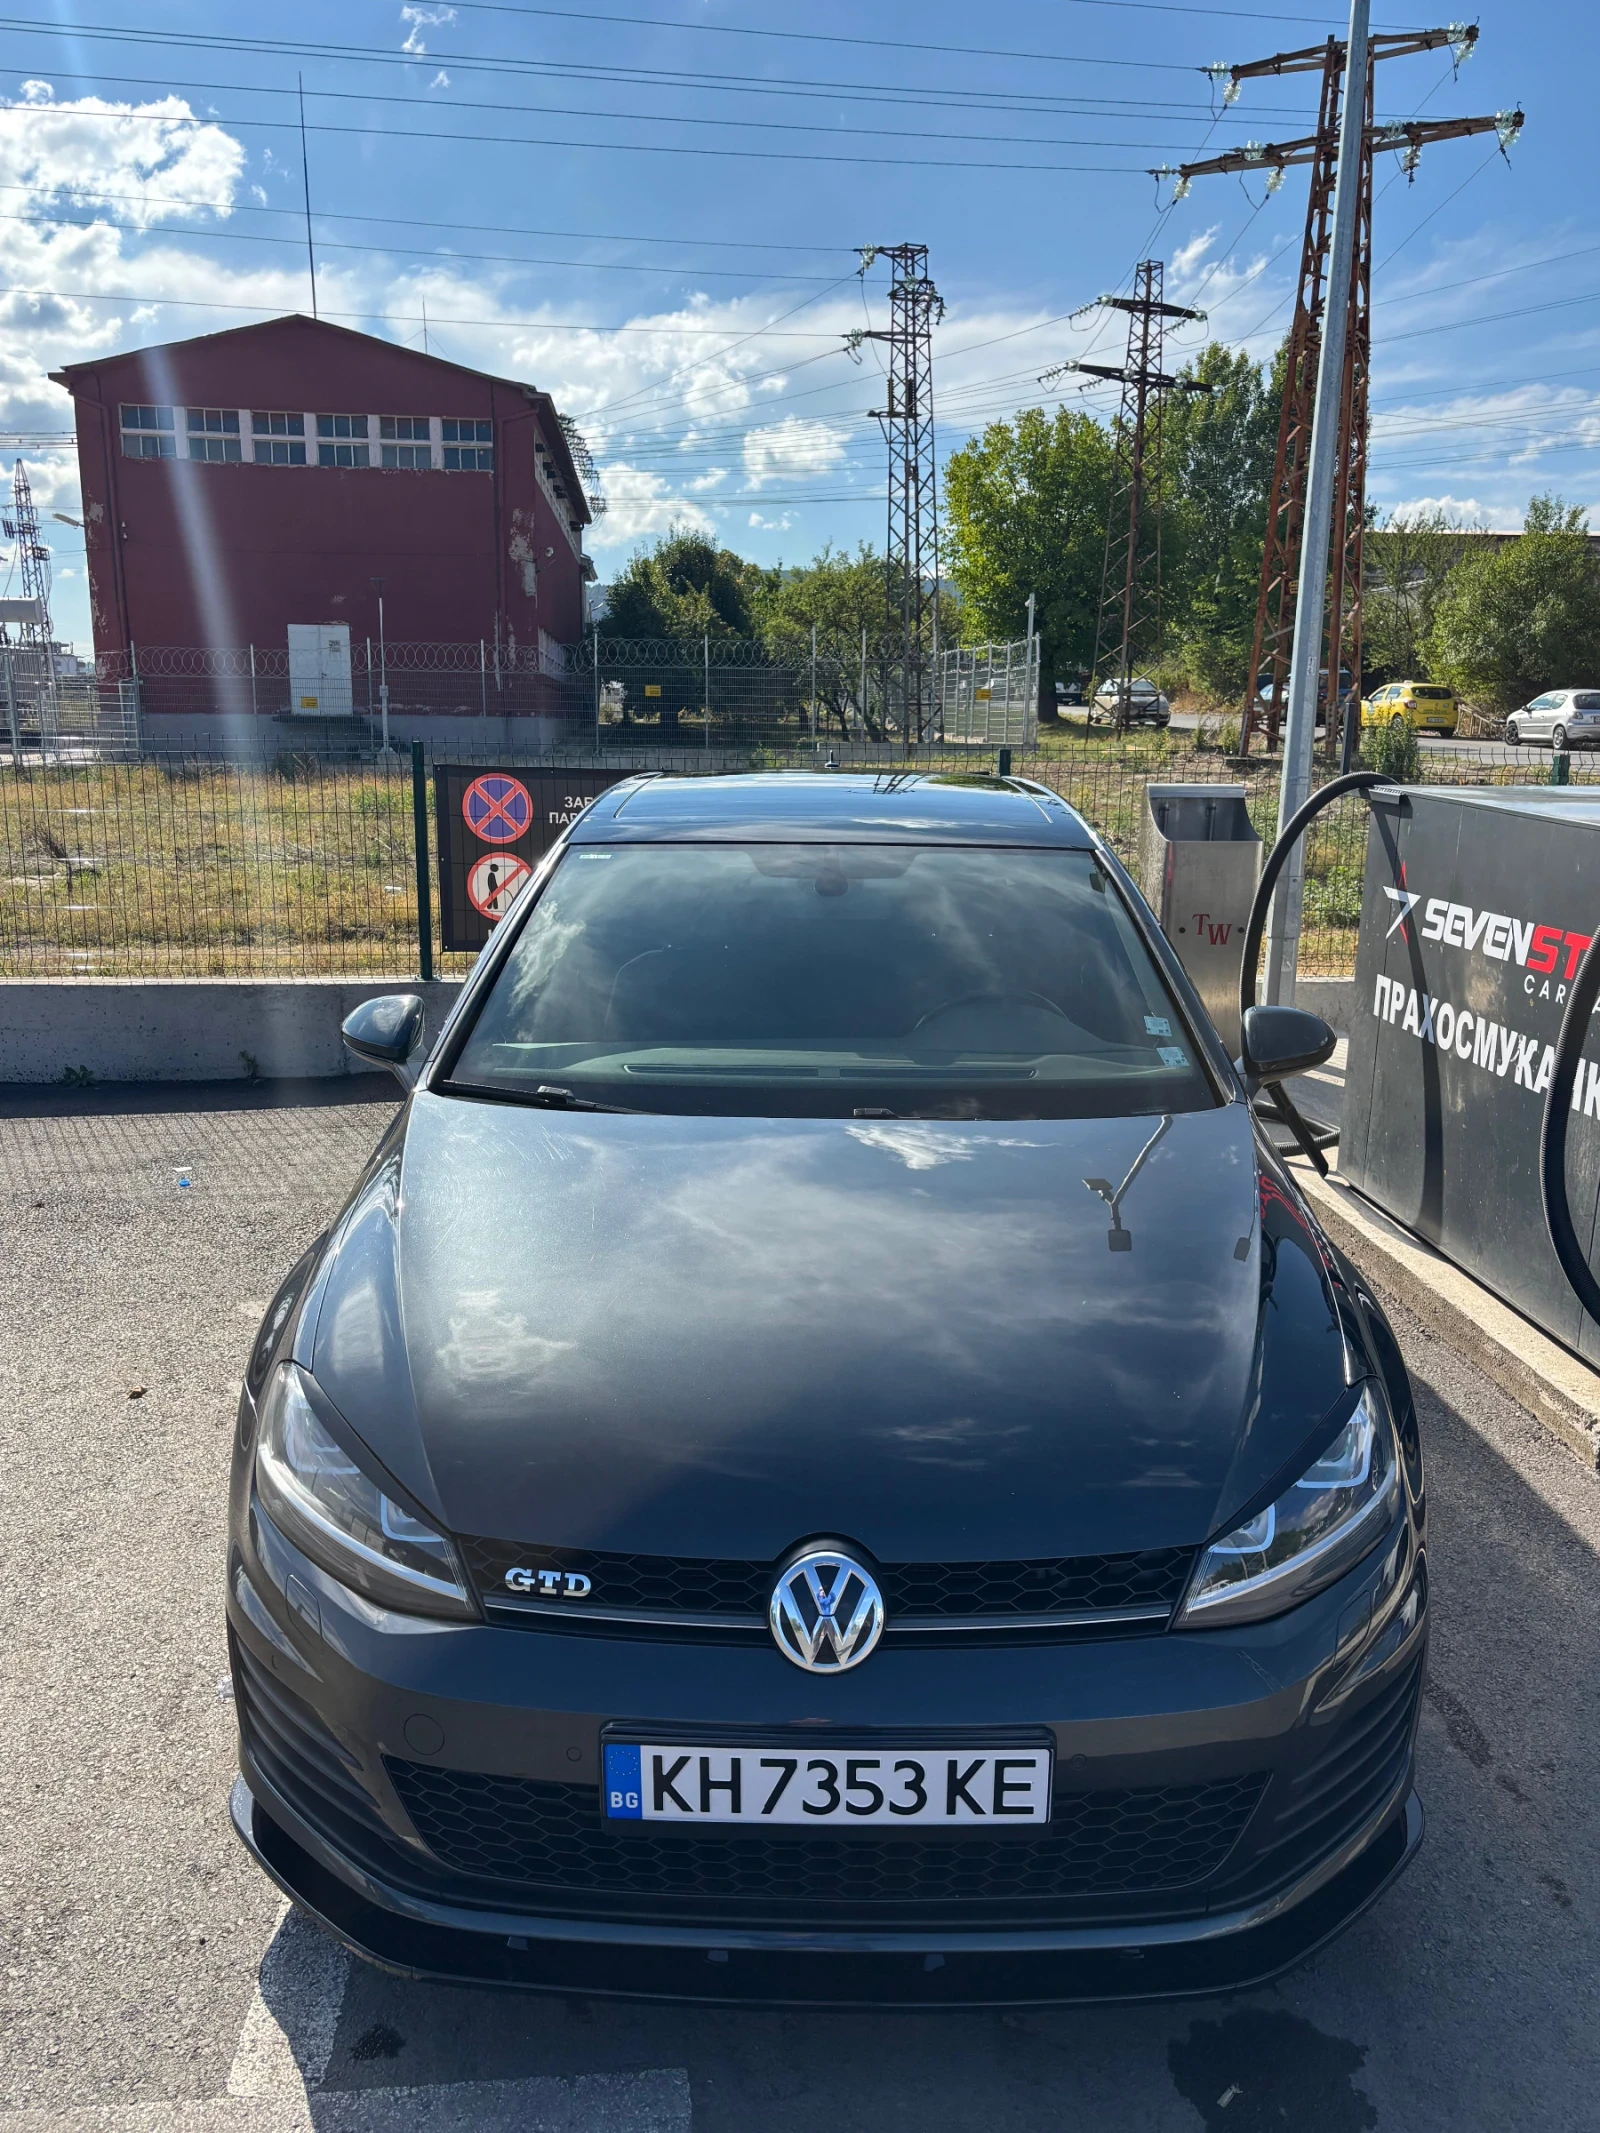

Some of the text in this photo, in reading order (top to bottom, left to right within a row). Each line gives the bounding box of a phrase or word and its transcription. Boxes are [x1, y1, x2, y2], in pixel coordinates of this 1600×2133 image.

[1191, 913, 1233, 946] TW
[1523, 974, 1567, 1005] CAR
[505, 1567, 592, 1597] GTD
[610, 1791, 640, 1810] BG
[652, 1754, 1037, 1816] KH 7353 KE
